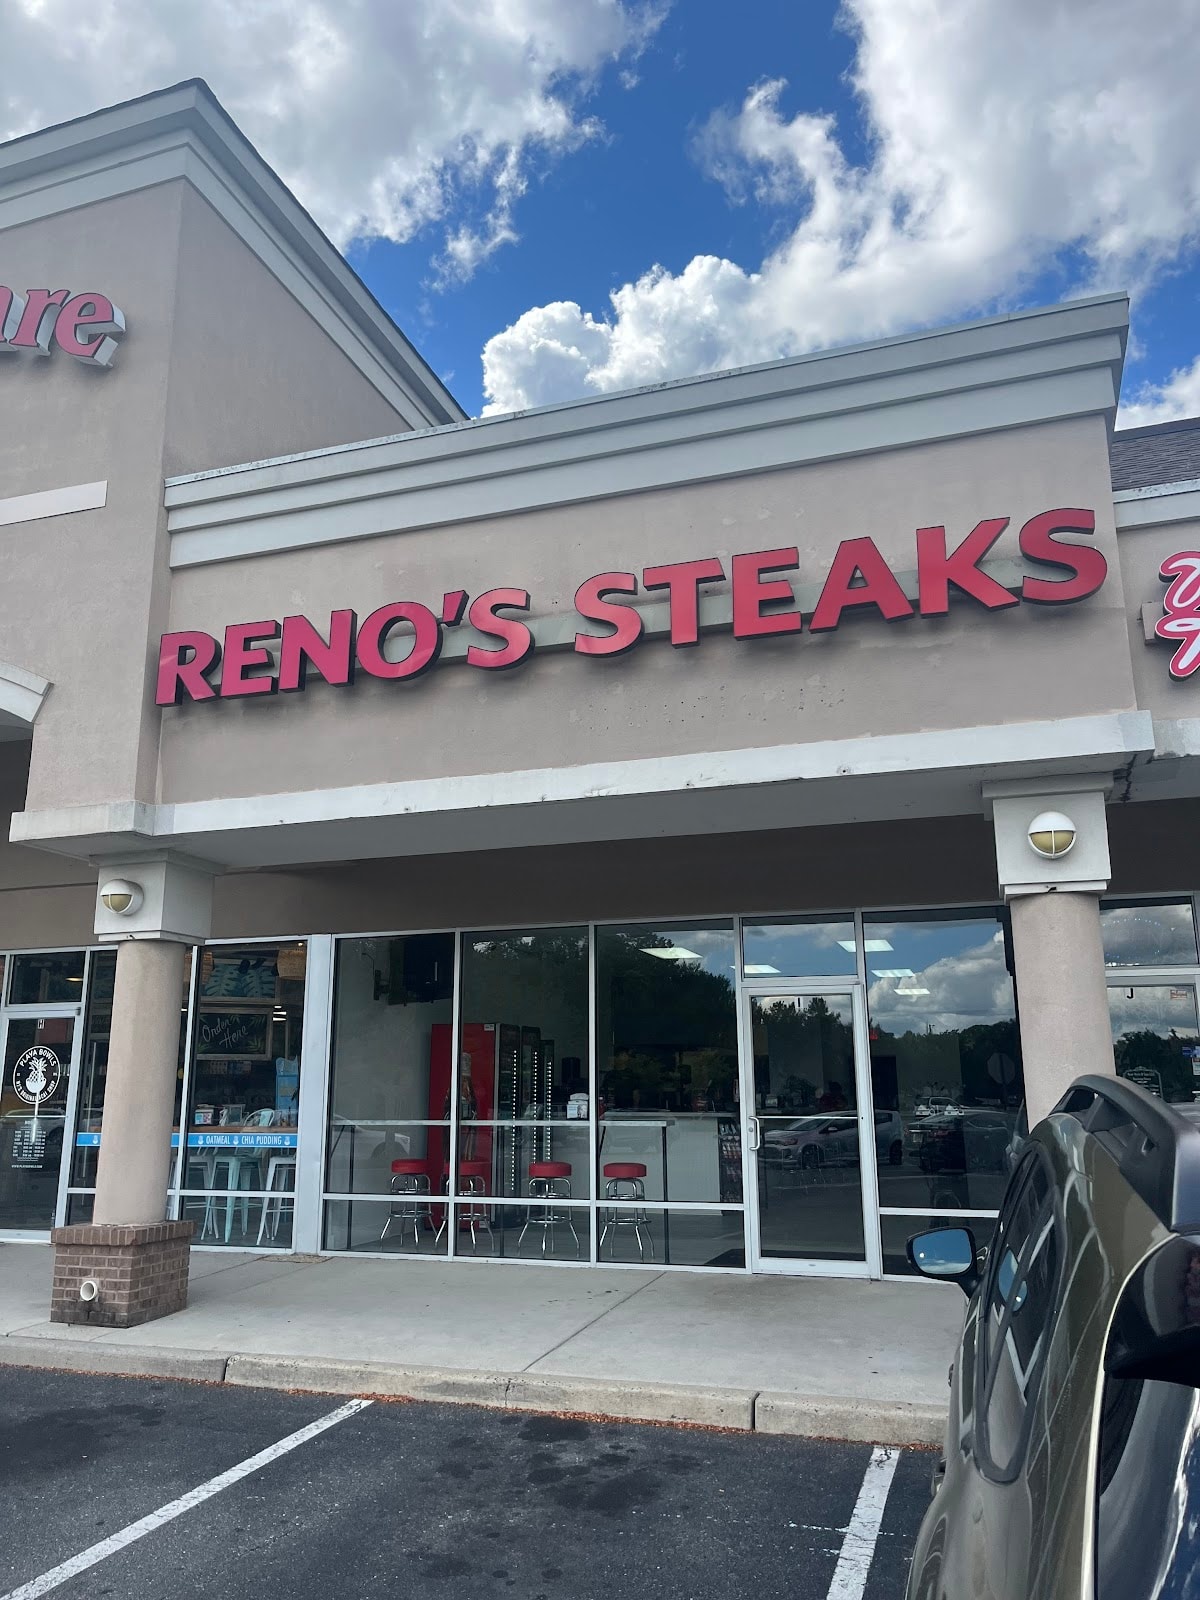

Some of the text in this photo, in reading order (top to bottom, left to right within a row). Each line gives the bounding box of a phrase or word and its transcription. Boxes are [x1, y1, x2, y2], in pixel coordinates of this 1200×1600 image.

[155, 587, 534, 707] RENO'S
[573, 508, 1108, 658] STEAKS
[202, 1017, 231, 1042] Order
[219, 1025, 249, 1048] Here
[19, 1048, 57, 1067] PLAYA BOWLS
[205, 1135, 282, 1145] OATMEAL CHIA PUDDING
